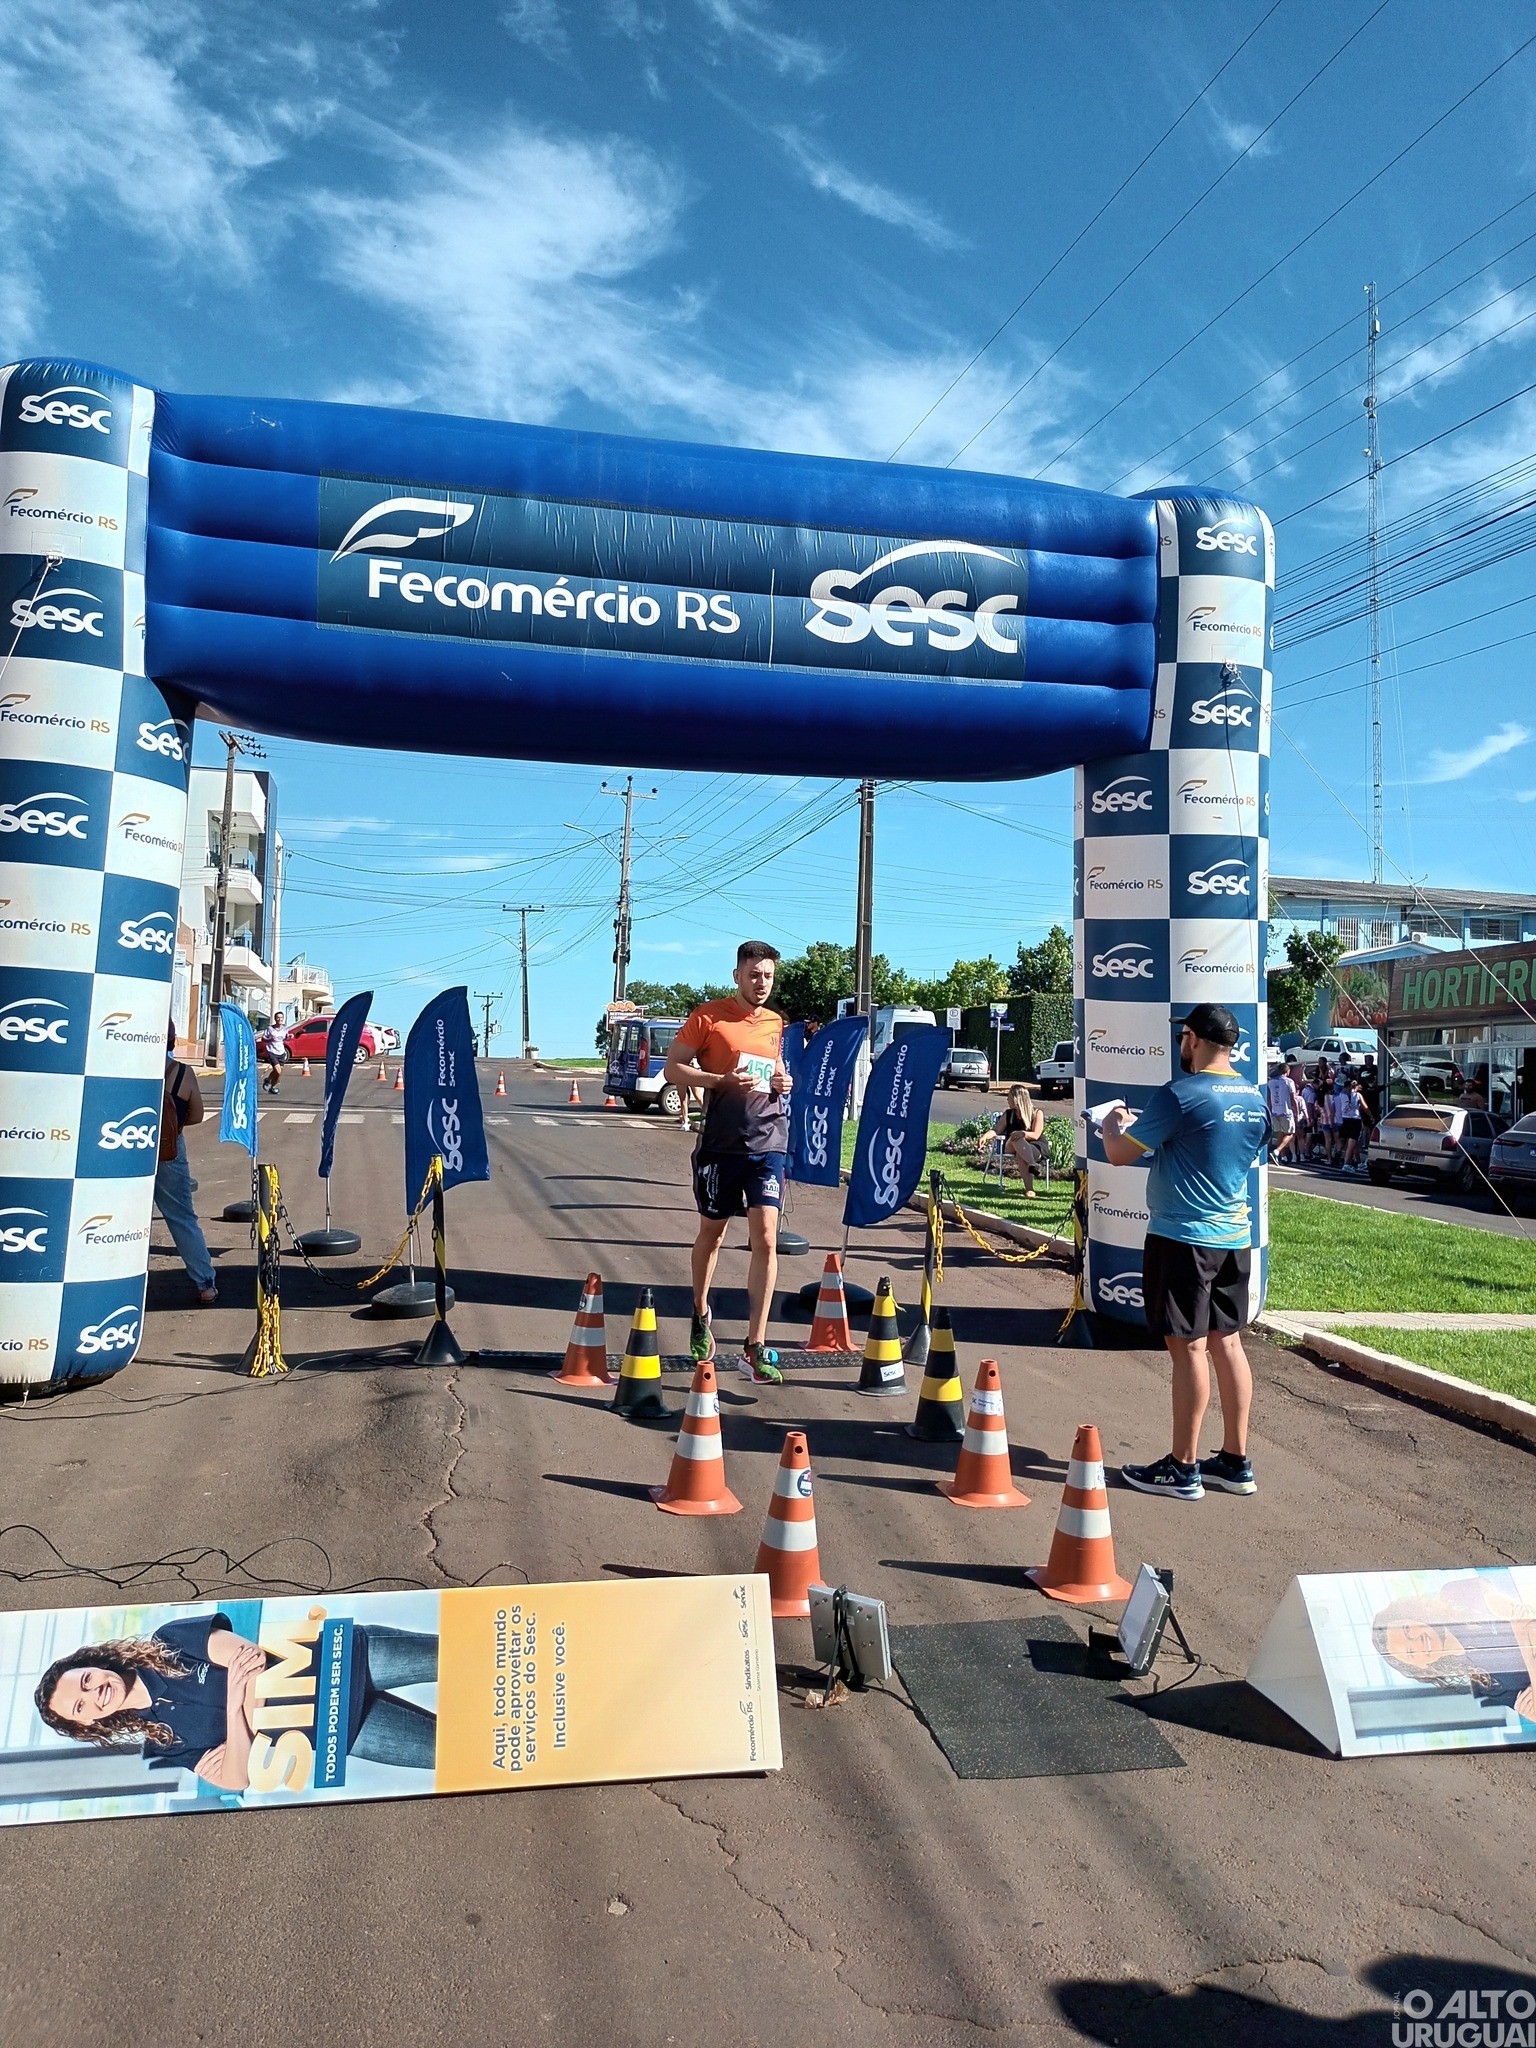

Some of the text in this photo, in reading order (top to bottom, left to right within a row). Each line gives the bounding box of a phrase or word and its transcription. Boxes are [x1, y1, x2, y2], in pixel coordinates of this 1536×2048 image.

[19, 394, 112, 435] Sesc
[10, 505, 119, 531] Fecomércio RS
[1196, 527, 1258, 556] Sesc
[368, 558, 742, 634] Fecomércio RS
[10, 599, 104, 637] Sesc
[805, 568, 1019, 654] Sesc
[1193, 620, 1262, 637] Fecomércio RS
[0, 710, 110, 734] Fecomércio RS
[1189, 700, 1253, 728] Sesc
[1091, 790, 1153, 814] Sesc
[1184, 794, 1244, 805] Fecomércio
[1246, 796, 1256, 806] RS
[0, 804, 89, 840] Sesc
[125, 828, 178, 852] Fecomércio
[1090, 879, 1144, 890] Fecomércio
[1147, 879, 1163, 889] RS
[1187, 871, 1250, 895] Sesc
[71, 923, 91, 936] RS
[117, 920, 174, 955] Sesc
[1092, 955, 1154, 978] Sesc
[1185, 962, 1244, 974] Fecomércio
[1246, 963, 1256, 974] RS
[106, 1028, 161, 1044] Fecomércio
[1091, 1042, 1145, 1057] Fecomércio
[1149, 1046, 1165, 1056] RS
[436, 1019, 445, 1086] Fecomércio
[448, 1051, 456, 1087] Senac
[745, 1059, 773, 1082] 456
[814, 1040, 834, 1096] Fecomércio
[823, 1067, 837, 1098] Senac
[887, 1044, 908, 1116] Fecomércio
[233, 1078, 248, 1129] Sesc
[899, 1080, 914, 1119] Senac
[1223, 1110, 1246, 1122] Sesc
[50, 1130, 71, 1141] RS
[97, 1120, 157, 1150] Sesc
[441, 1098, 464, 1173] Sesc
[808, 1106, 829, 1168] Sesc
[874, 1128, 905, 1209] Sesc
[1093, 1202, 1149, 1221] Fecomércio
[86, 1231, 143, 1245] Fecomércio
[1098, 1277, 1146, 1308] Ses
[27, 1338, 49, 1352] RS
[76, 1321, 139, 1355] Sesc
[1154, 1475, 1175, 1484] FILA
[739, 1585, 747, 1609] Senac
[741, 1619, 749, 1639] Sesc
[198, 1661, 210, 1685] Sesc
[523, 1612, 538, 1763] serviços do Sesc.
[552, 1622, 566, 1748] Inclusive você.
[325, 1623, 345, 1782] TODOS PODEM SER SESC.
[493, 1609, 508, 1769] Aqui, todo mundo
[508, 1605, 523, 1771] pode aproveitar os
[746, 1701, 754, 1713] RS
[747, 1714, 757, 1762] Fecomércio
